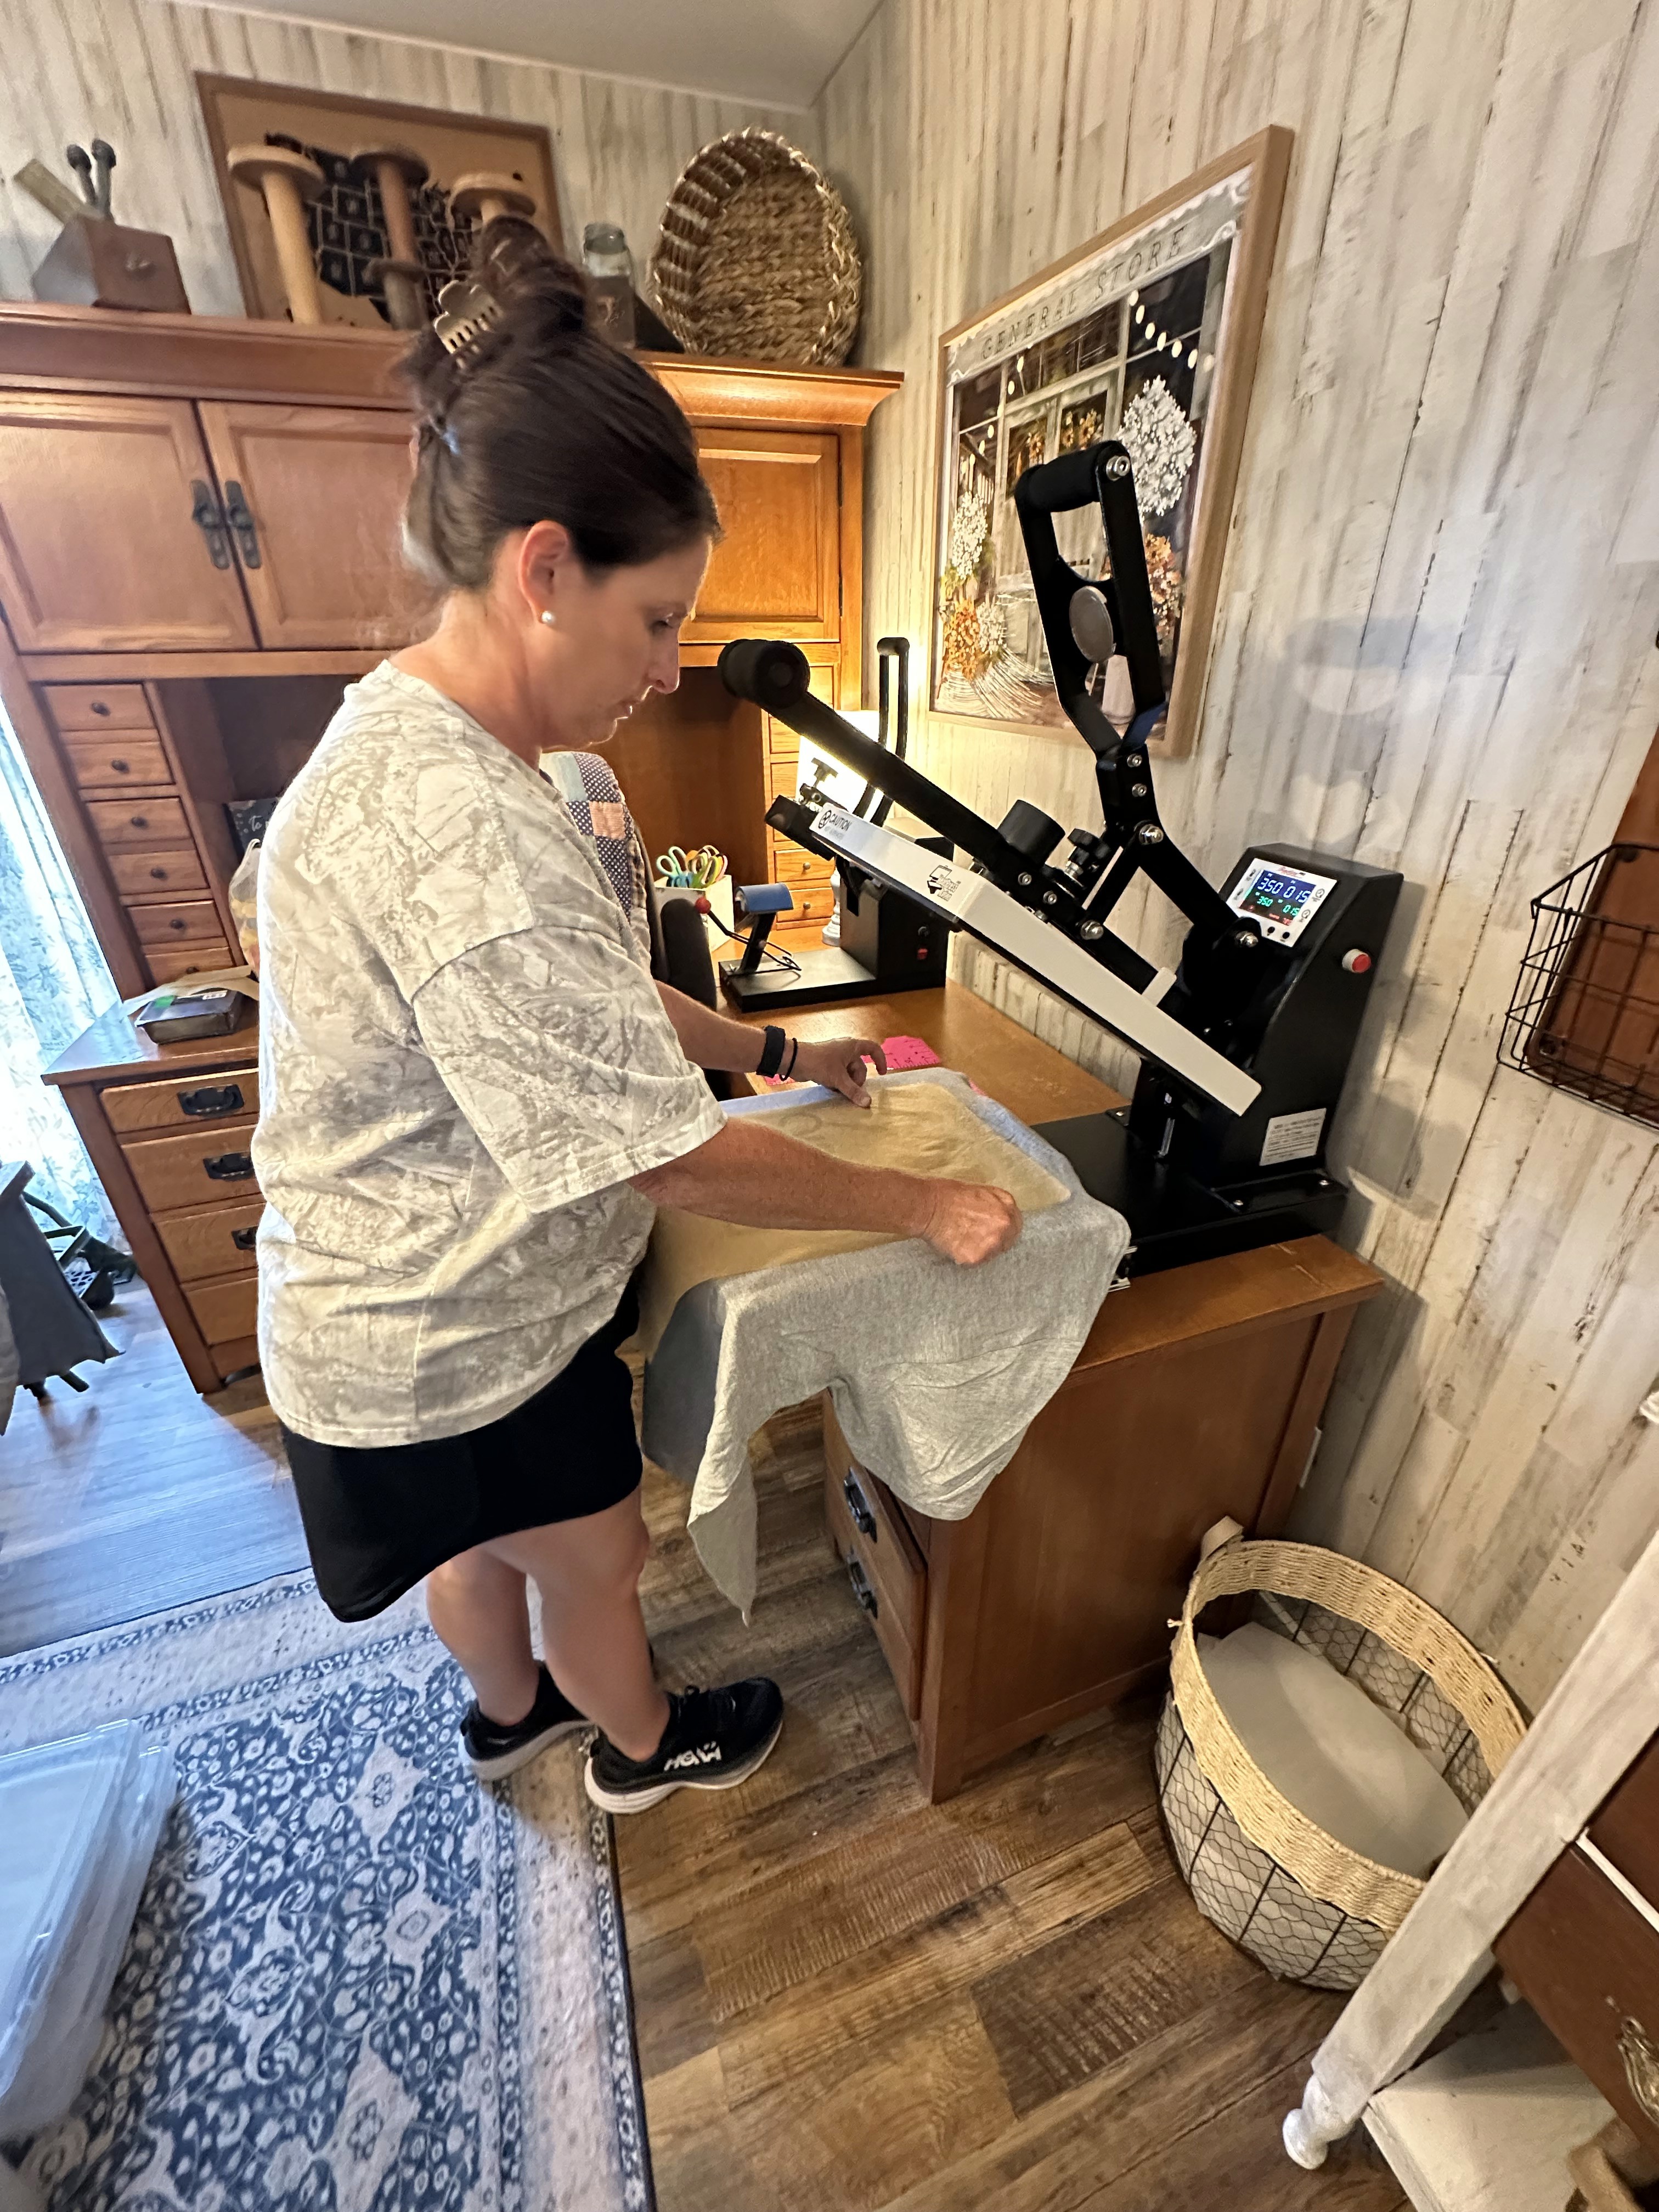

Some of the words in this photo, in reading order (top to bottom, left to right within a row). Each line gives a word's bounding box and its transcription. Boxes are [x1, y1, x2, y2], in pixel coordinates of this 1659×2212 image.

[981, 289, 1079, 360] GENERAL
[1094, 224, 1188, 300] STORE
[829, 814, 852, 831] CAUTION
[1257, 877, 1284, 895] 350
[1283, 885, 1311, 903] 015
[1257, 895, 1273, 907] 350
[1283, 905, 1300, 916] 015
